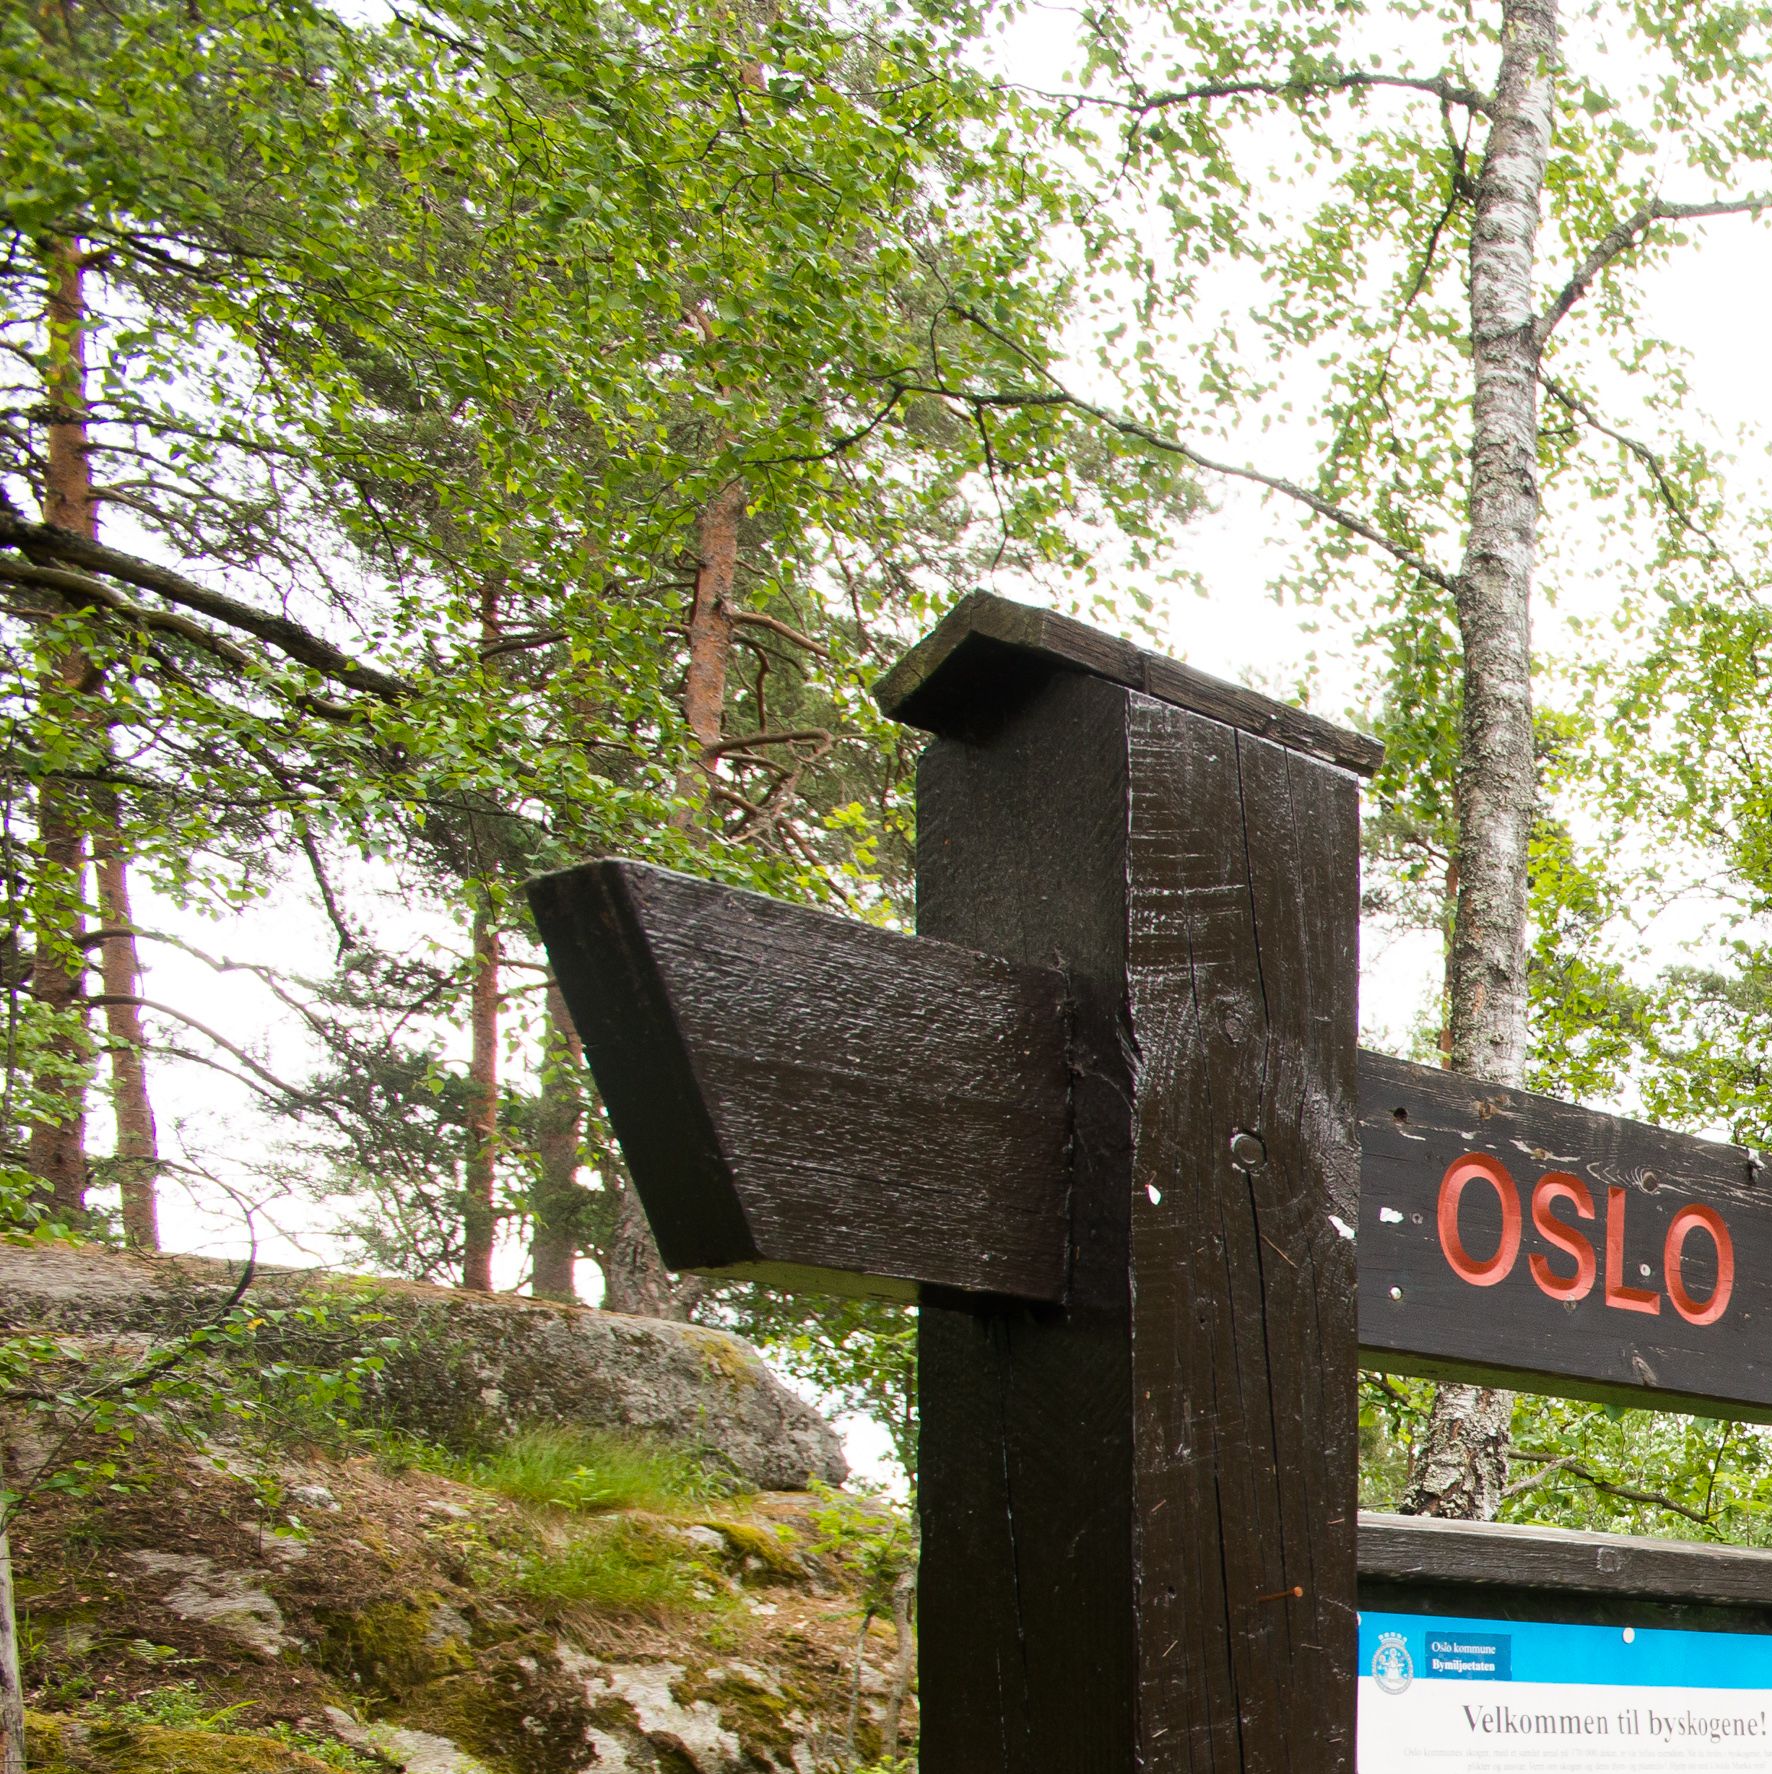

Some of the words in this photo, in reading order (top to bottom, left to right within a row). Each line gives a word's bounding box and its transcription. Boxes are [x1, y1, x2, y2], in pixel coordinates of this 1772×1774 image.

[1437, 1152, 1735, 1326] OSLO
[1431, 1641, 1452, 1653] Oslo
[1453, 1642, 1496, 1655] kommune
[1432, 1658, 1496, 1673] Bymiljøetaten
[1462, 1704, 1609, 1735] Velkommen
[1617, 1709, 1640, 1735] til
[1648, 1709, 1767, 1744] byskogene!
